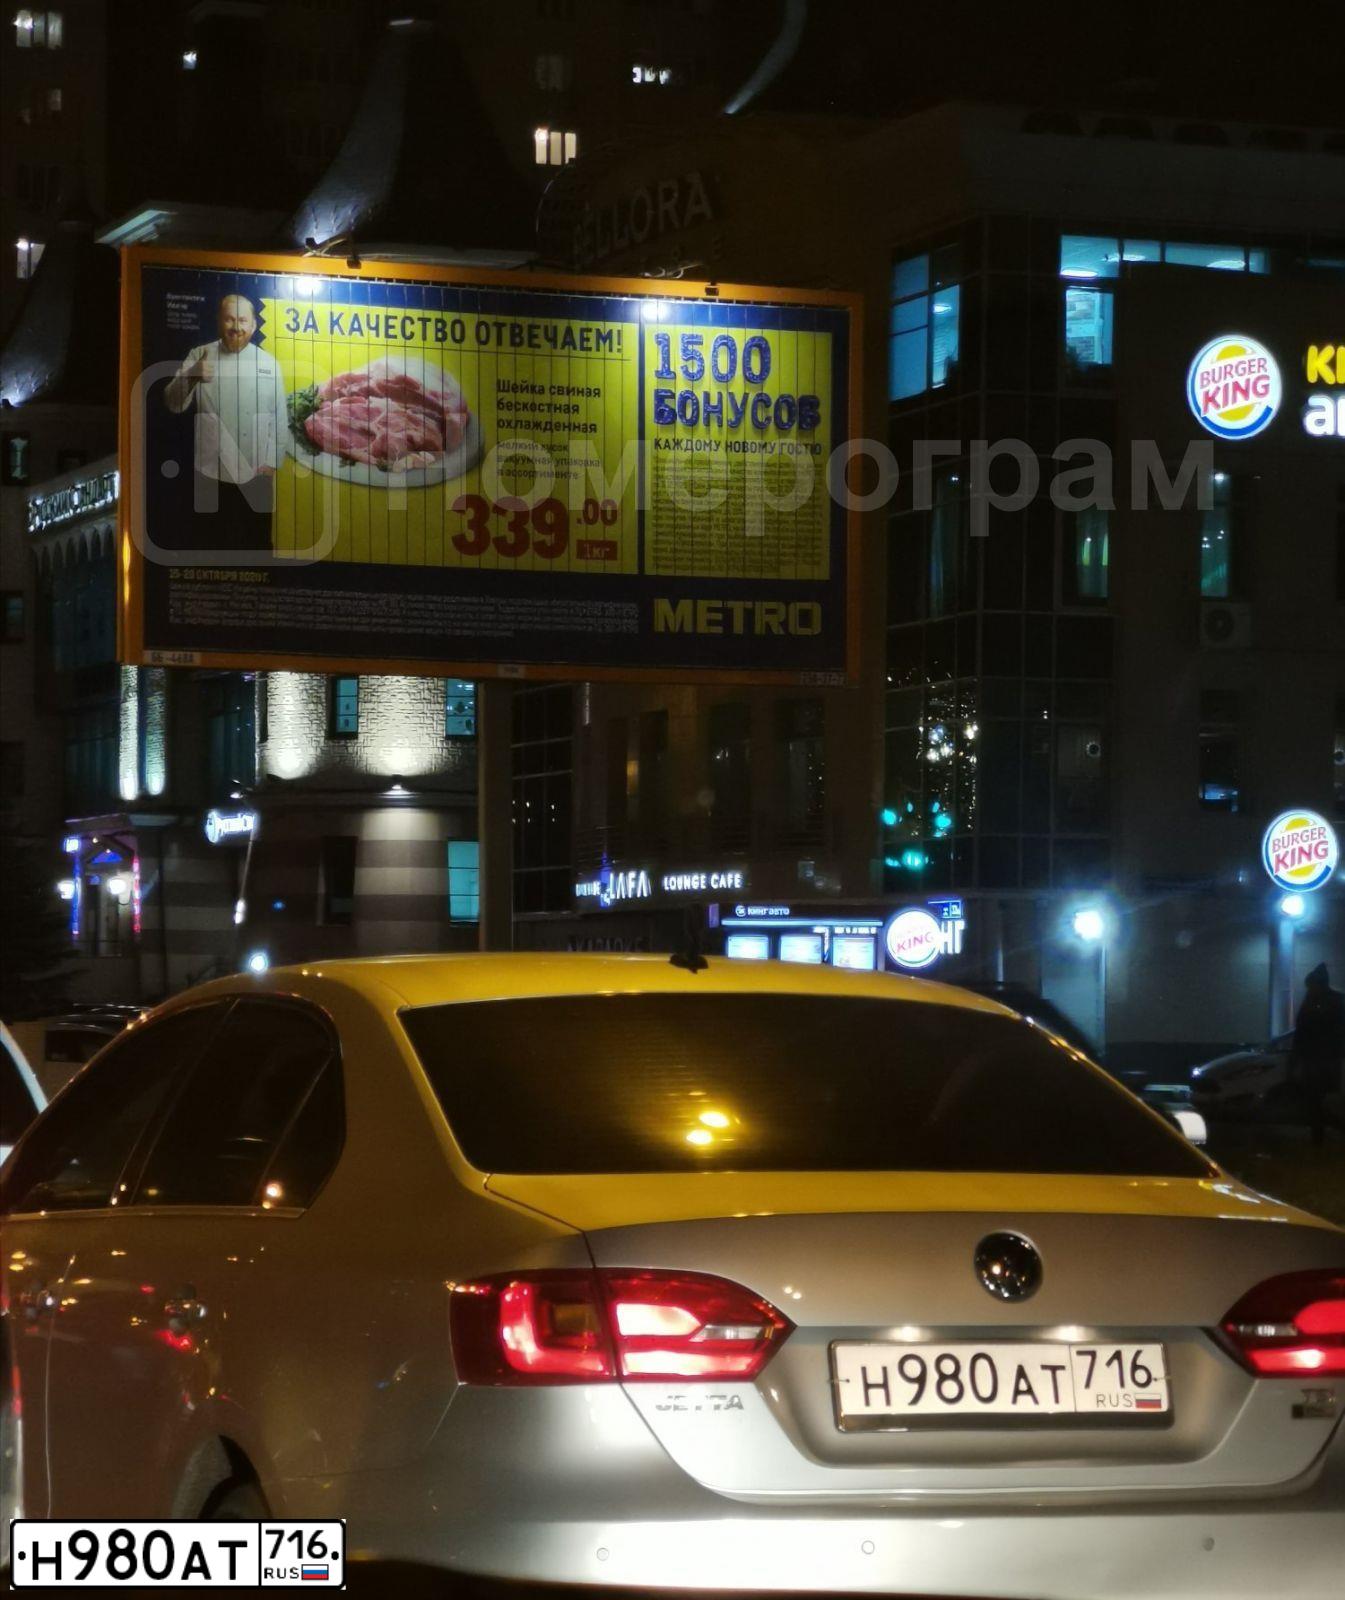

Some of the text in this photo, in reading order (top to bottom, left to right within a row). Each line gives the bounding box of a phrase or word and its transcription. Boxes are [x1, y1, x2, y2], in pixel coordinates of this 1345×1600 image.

[285, 307, 623, 353] ЗА КАЧЕСТВО ОТВЕЧАЕМ!
[654, 332, 772, 384] 1500
[1199, 356, 1268, 389] BURGER
[1306, 344, 1345, 386] К
[496, 379, 601, 398] Шейка свиная
[496, 397, 580, 415] бескостная
[1201, 374, 1271, 417] KING
[496, 418, 598, 434] охлажденная
[653, 388, 821, 431] БОНУСОВ
[1304, 394, 1345, 437] а
[654, 438, 823, 456] КАЖДОМУ НОВОМУ ГОСТЮ
[451, 493, 569, 560] 339
[653, 598, 823, 637] METRO
[1271, 826, 1327, 854] BURGER
[1273, 840, 1330, 876] KING
[663, 873, 707, 892] LOUNGE
[710, 872, 742, 890] CAFE
[896, 931, 934, 955] KING
[861, 1349, 1153, 1408] Н980АТ 716
[1095, 1392, 1134, 1408] RUS
